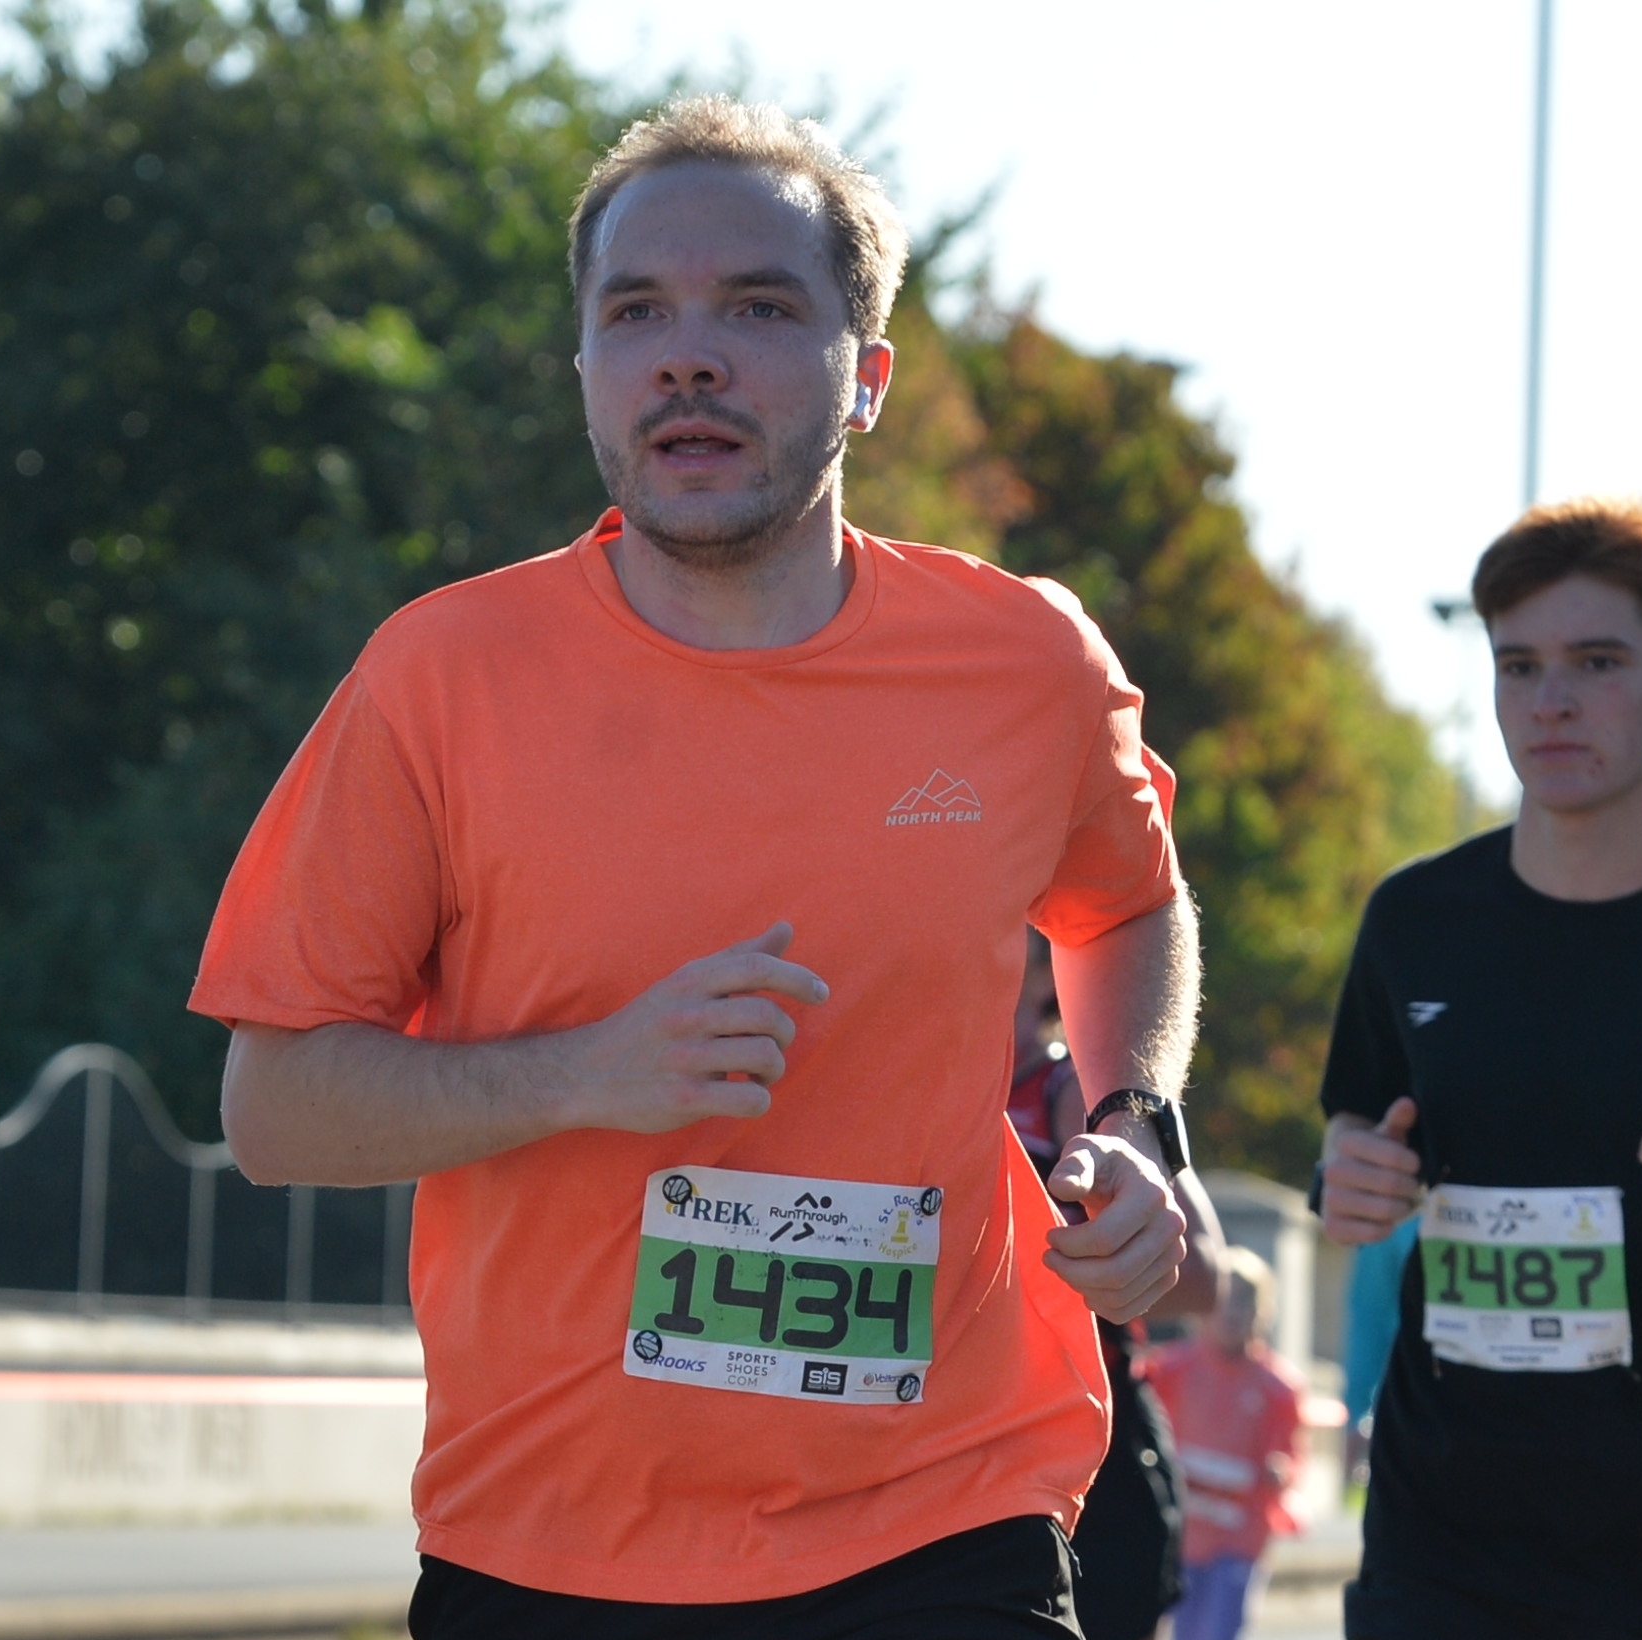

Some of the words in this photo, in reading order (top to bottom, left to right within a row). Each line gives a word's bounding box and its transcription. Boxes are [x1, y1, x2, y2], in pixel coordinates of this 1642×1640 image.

[885, 811, 941, 827] NORTH
[945, 811, 982, 823] PEAK
[676, 1197, 754, 1226] TREK
[769, 1206, 848, 1226] RunThrough
[878, 1242, 919, 1260] Hospice
[1439, 1244, 1606, 1307] 1487
[654, 1248, 913, 1354] 1434
[728, 1351, 777, 1366] SPORTS
[726, 1363, 768, 1377] SHOES
[723, 1374, 758, 1388] .COM
